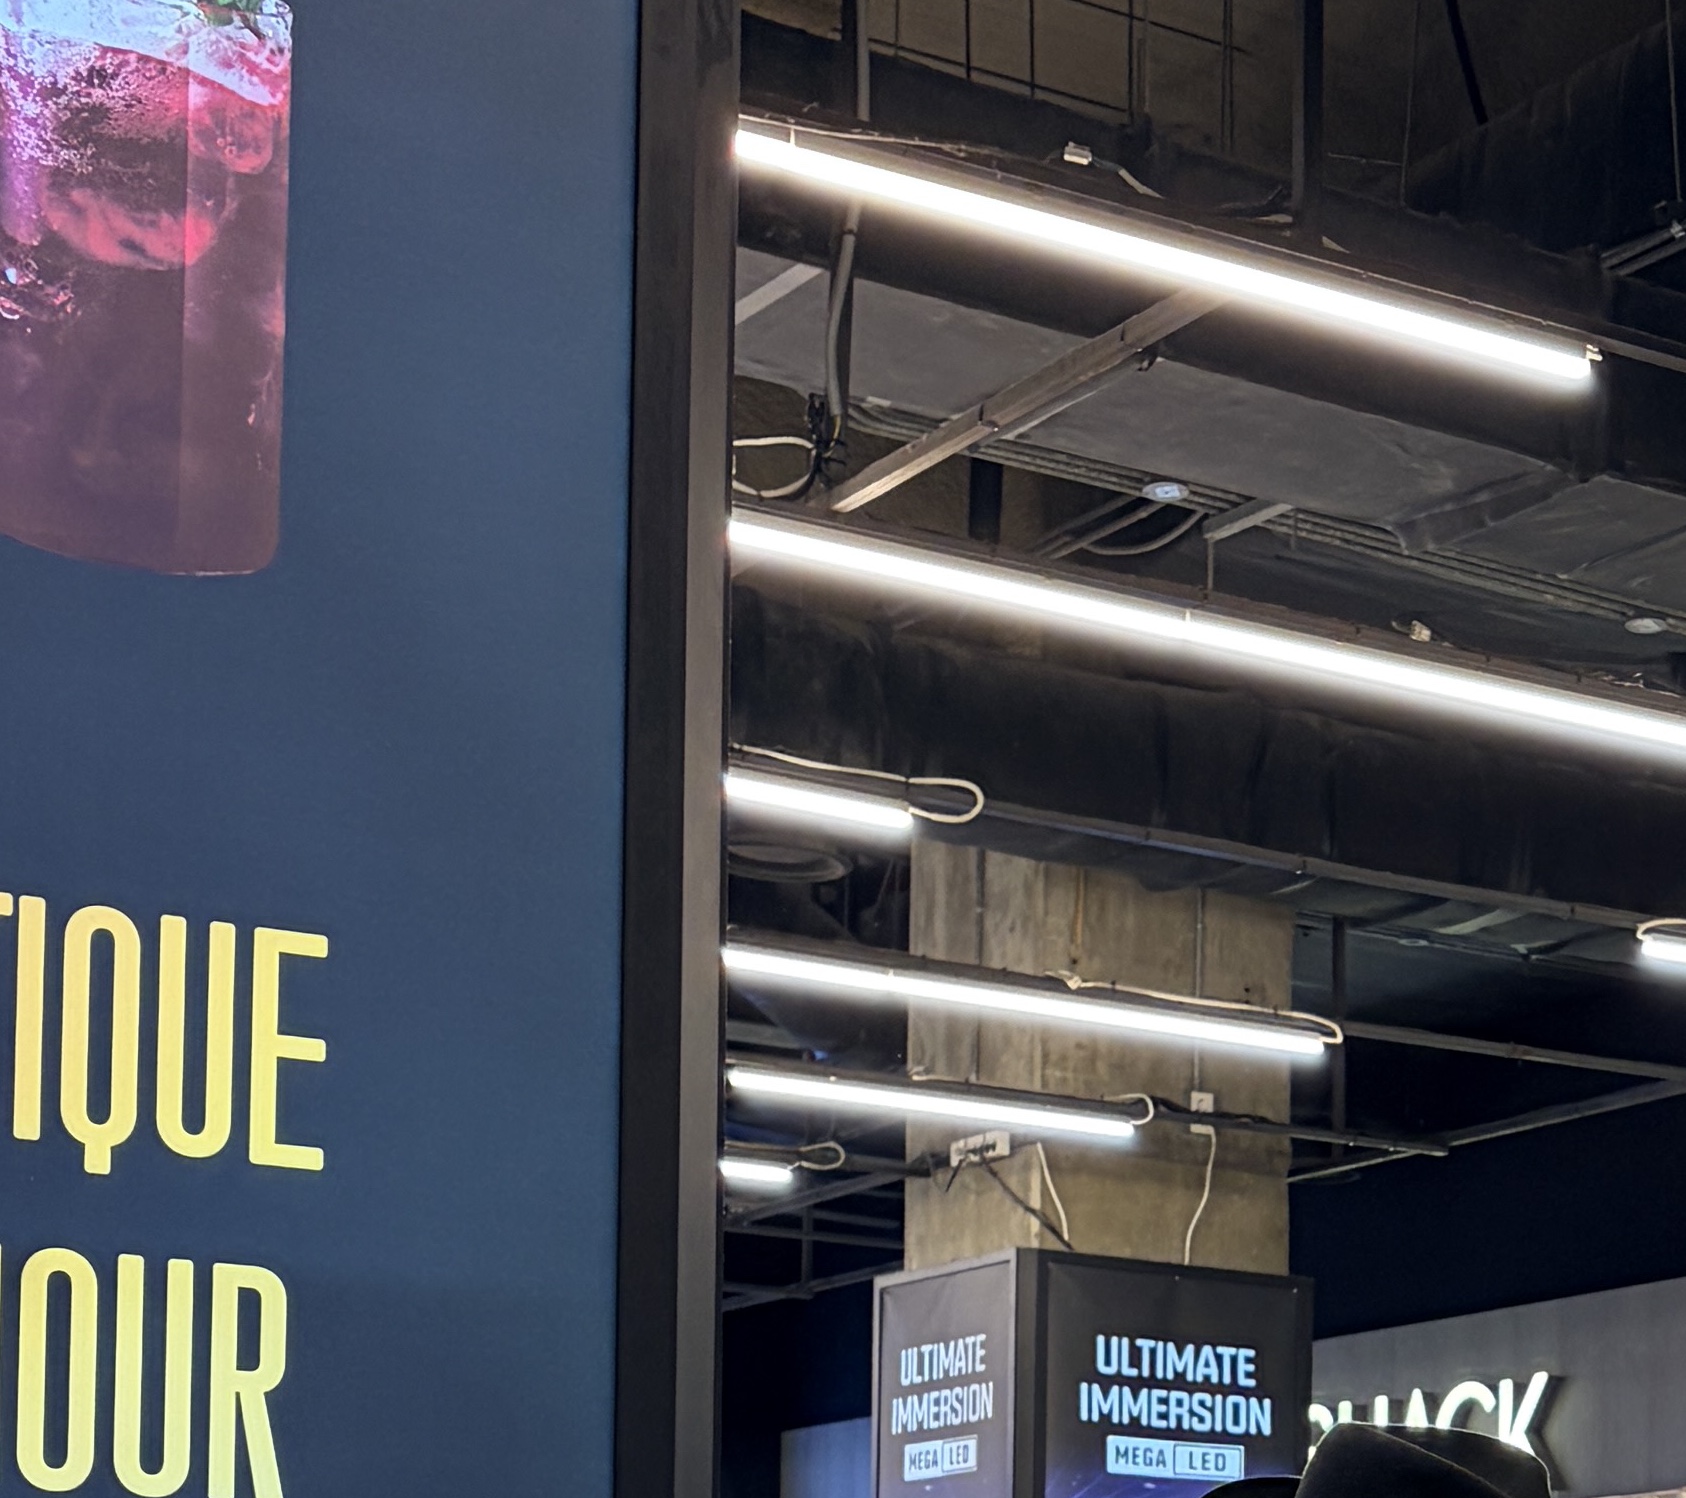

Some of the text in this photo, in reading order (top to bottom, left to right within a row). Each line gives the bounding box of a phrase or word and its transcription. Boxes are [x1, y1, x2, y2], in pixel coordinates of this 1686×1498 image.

[0, 892, 329, 1175] IQUE
[900, 1333, 987, 1387] ULTIMATE
[1095, 1334, 1257, 1388] ULTIMATE
[891, 1380, 994, 1436] IMMERSION
[1079, 1381, 1272, 1437] IMMERSION
[908, 1444, 970, 1472] MEGA LED
[1114, 1445, 1227, 1472] MEGA LED
